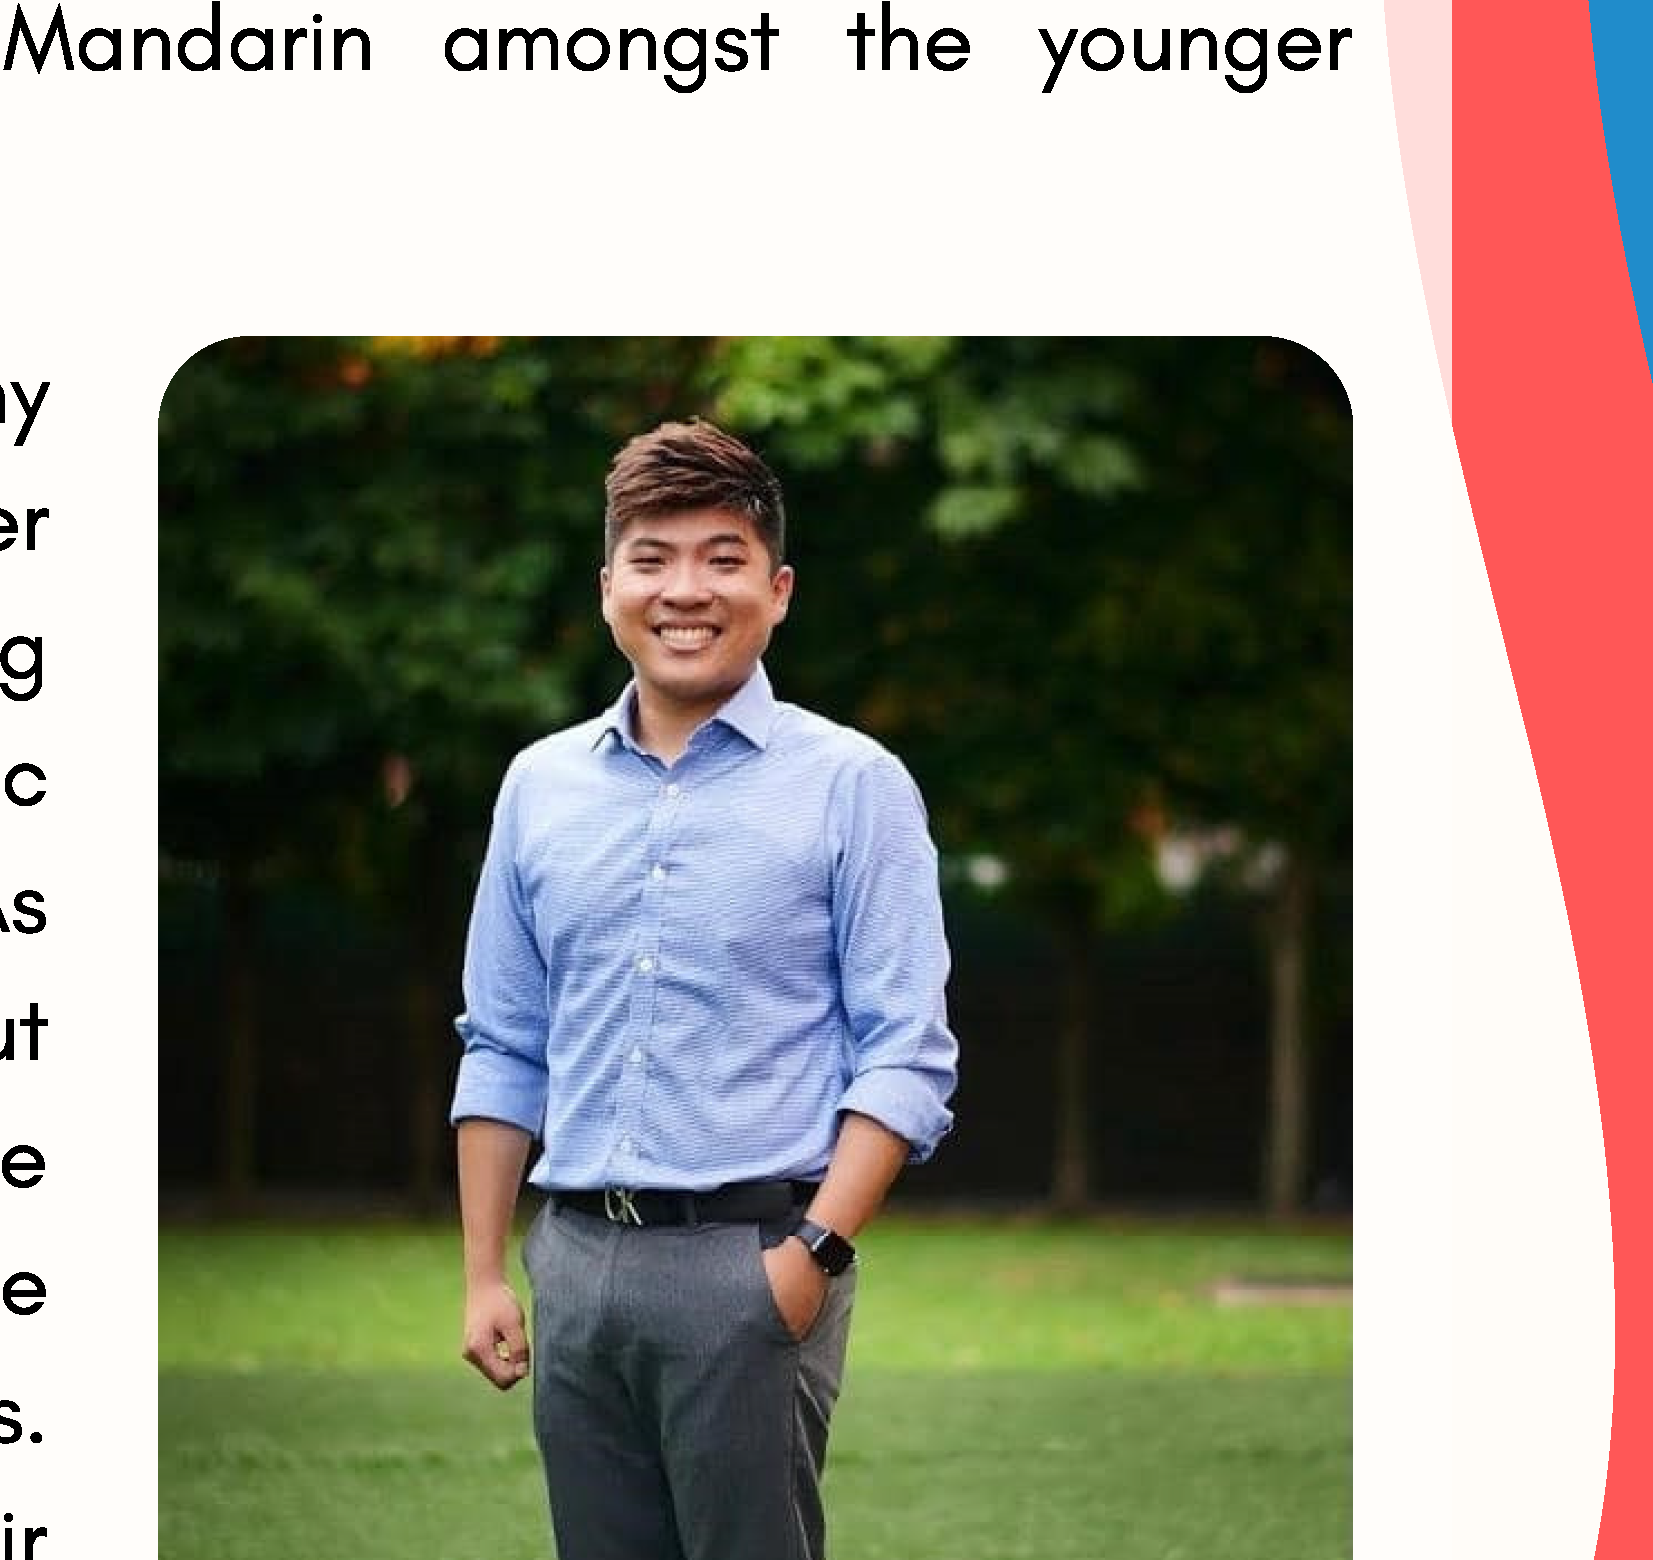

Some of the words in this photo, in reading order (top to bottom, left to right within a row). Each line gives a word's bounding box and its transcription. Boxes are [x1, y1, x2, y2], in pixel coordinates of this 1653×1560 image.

[3, 1, 370, 74] Mandarin
[445, 13, 779, 93] amongst
[847, 1, 970, 71] the
[1038, 28, 1352, 93] younger
